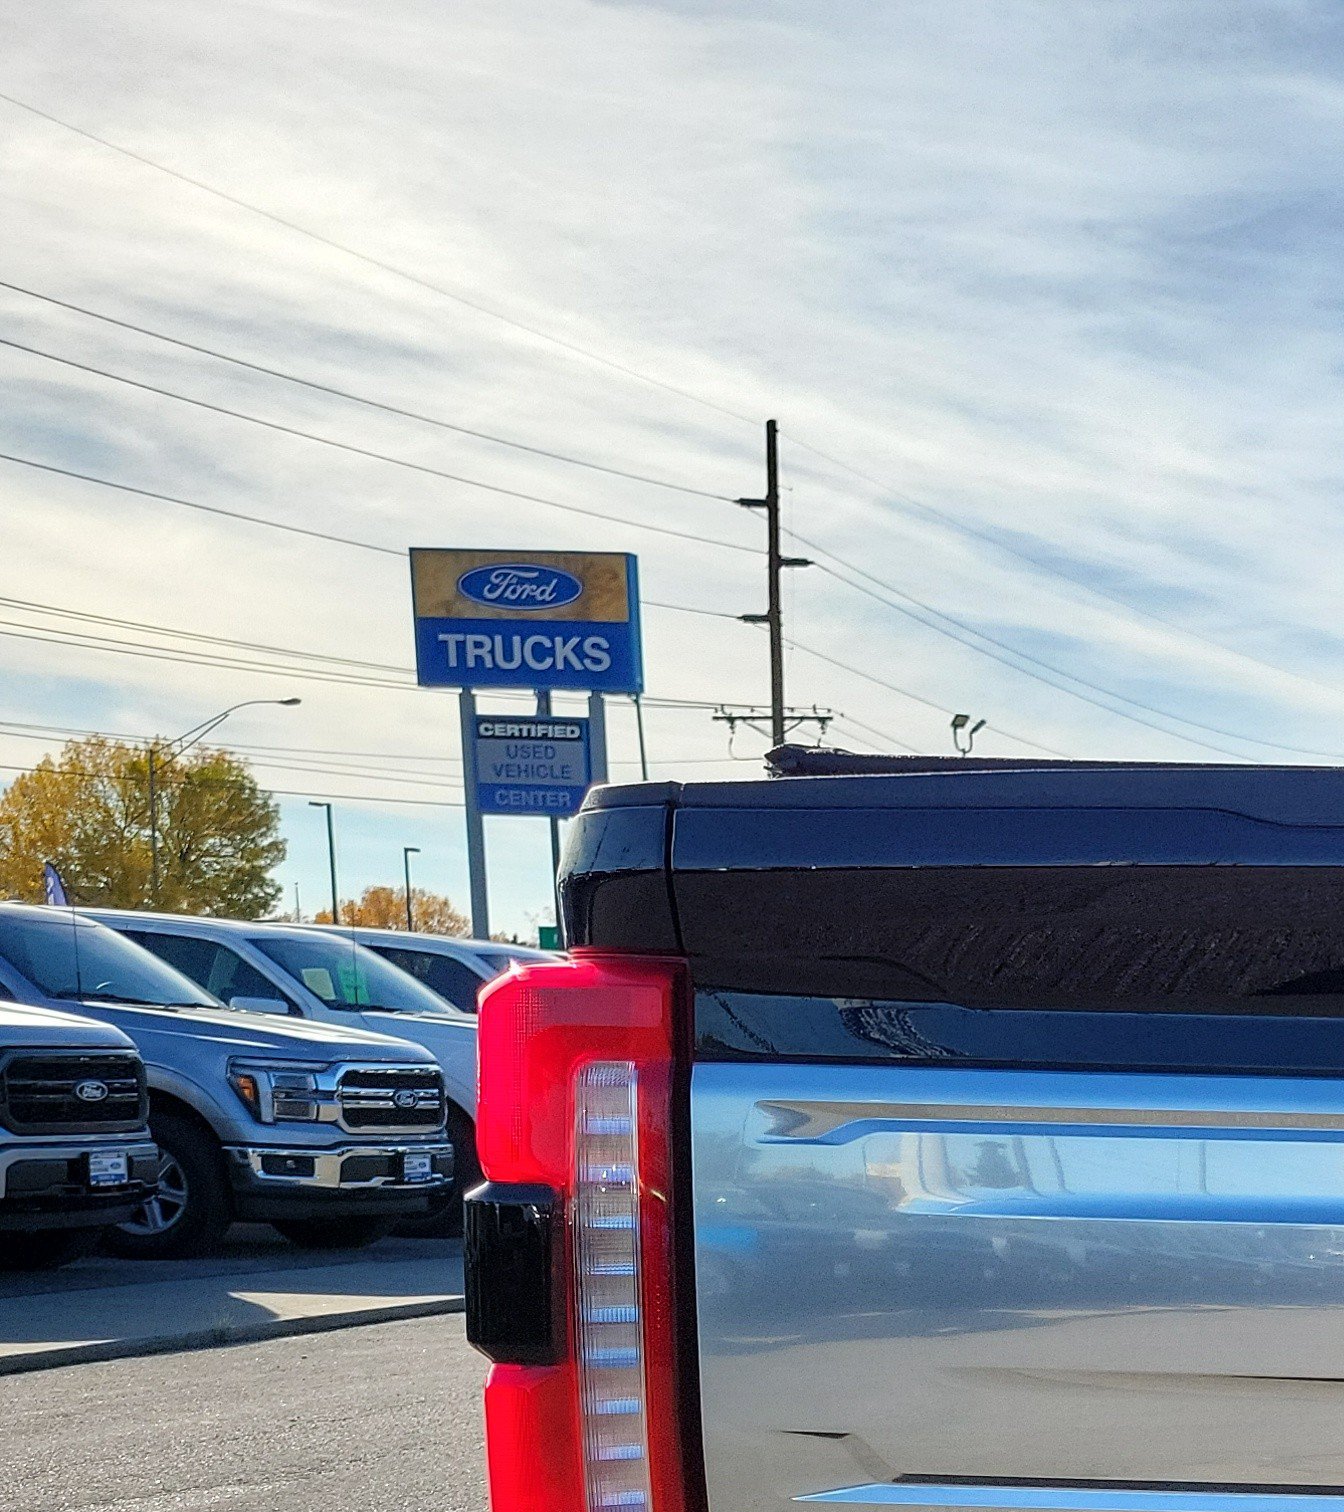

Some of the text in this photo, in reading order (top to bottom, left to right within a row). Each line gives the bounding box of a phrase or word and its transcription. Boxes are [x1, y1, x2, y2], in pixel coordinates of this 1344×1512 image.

[483, 568, 558, 601] Ford
[437, 633, 612, 672] TRUCKS
[479, 722, 581, 739] CERTIFIED
[505, 744, 556, 760] USED
[493, 763, 572, 779] VEHICLE
[494, 788, 571, 806] CENTER
